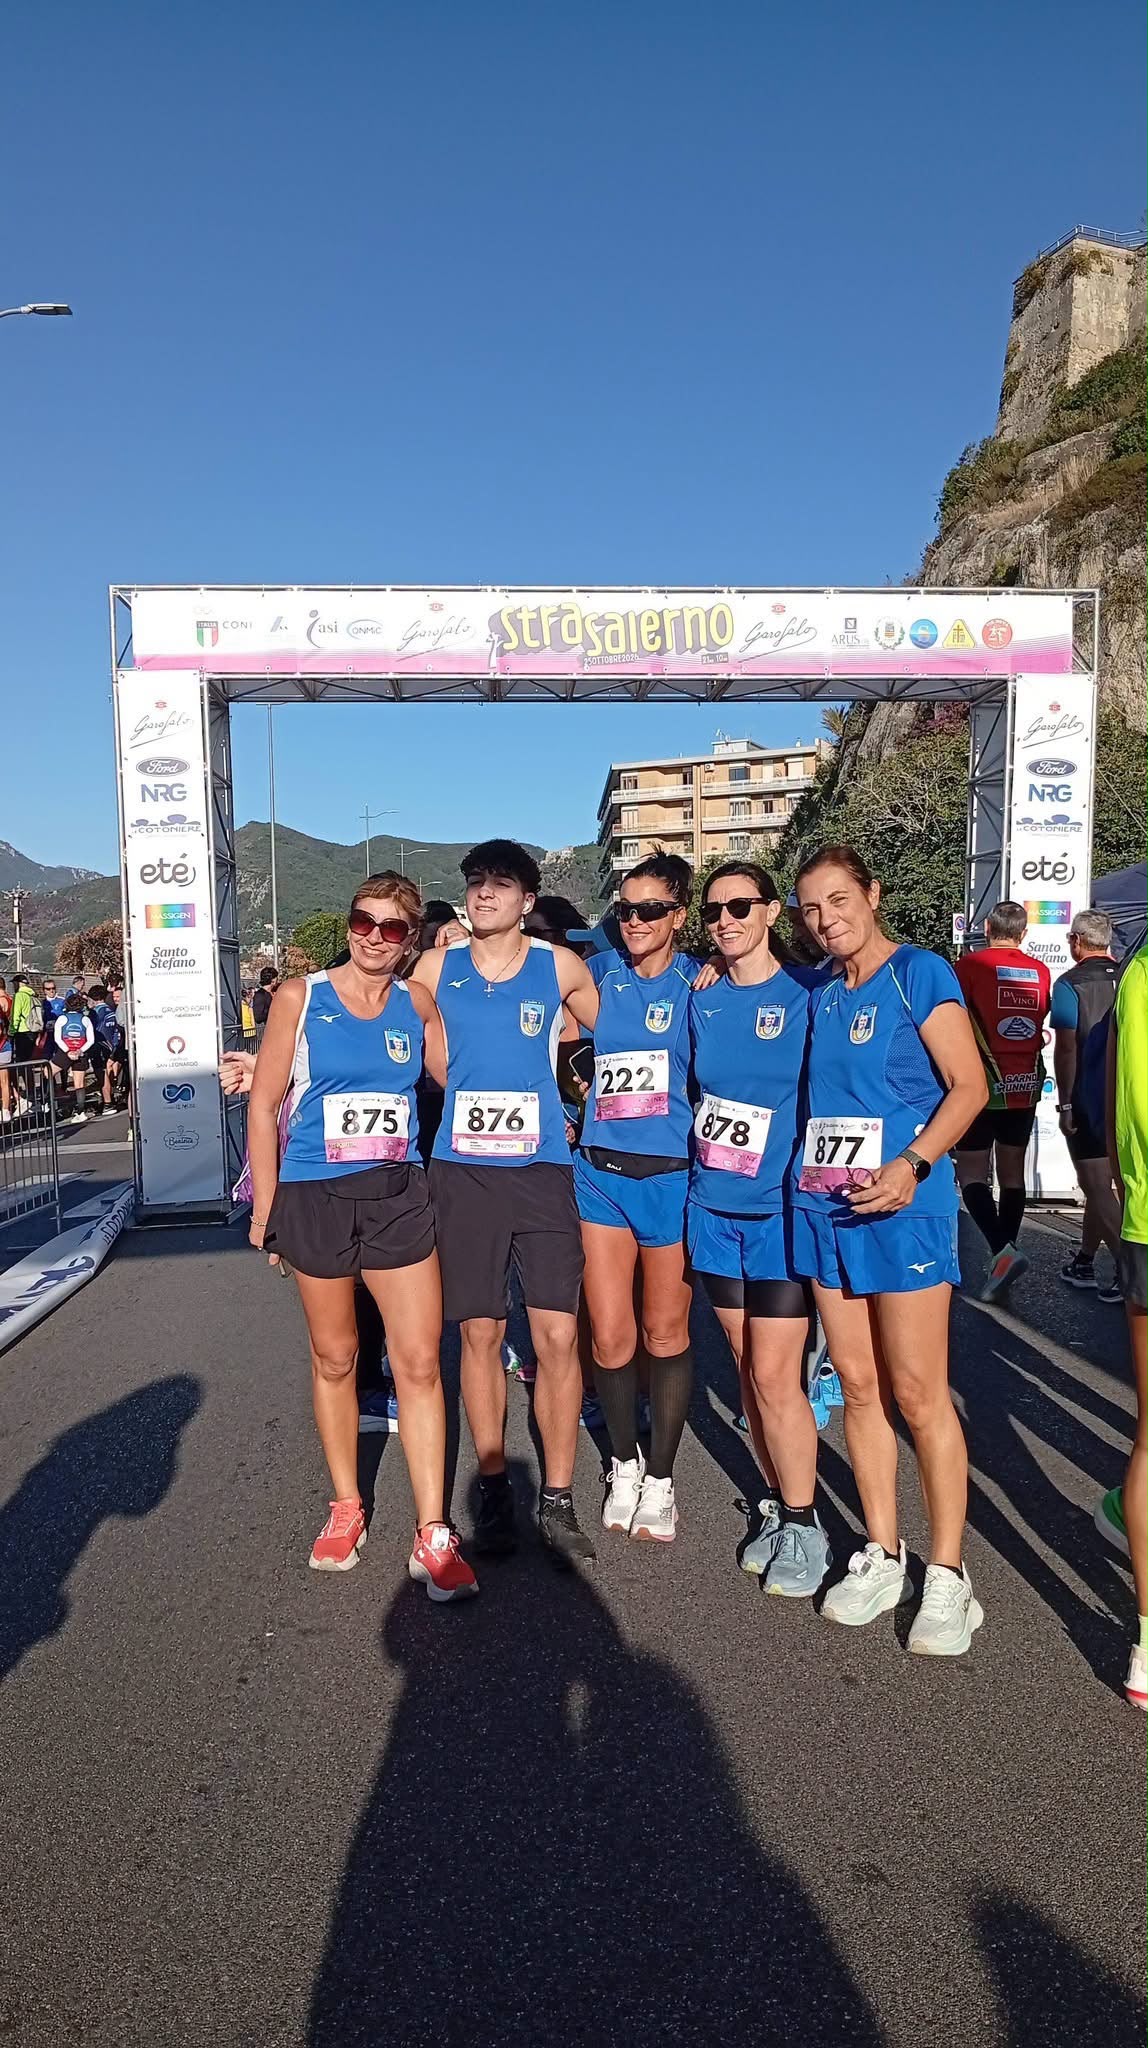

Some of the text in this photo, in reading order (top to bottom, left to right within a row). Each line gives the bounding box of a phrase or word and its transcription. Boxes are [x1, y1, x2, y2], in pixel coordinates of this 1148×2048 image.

[222, 620, 253, 630] CONI
[397, 615, 472, 653] Garofalo
[738, 616, 818, 655] Garofalo
[831, 634, 861, 645] ARUS
[129, 710, 195, 742] Garofalo
[1022, 713, 1085, 742] Garofalo
[146, 759, 179, 774] Ford
[1036, 760, 1068, 775] Ford
[140, 782, 188, 803] NRG
[1027, 783, 1073, 803] NRG
[138, 825, 202, 834] COTONIERE
[1023, 825, 1083, 833] COTONIERE
[139, 852, 190, 885] eté
[1021, 852, 1069, 882] eté
[152, 946, 188, 958] Santo
[1026, 941, 1061, 953] Santo
[150, 957, 196, 971] Stefano
[168, 1060, 199, 1068] LEONARDO
[600, 1066, 655, 1095] 222
[341, 1108, 399, 1136] 875
[467, 1107, 525, 1132] 876
[701, 1112, 751, 1147] 878
[814, 1135, 865, 1166] 877
